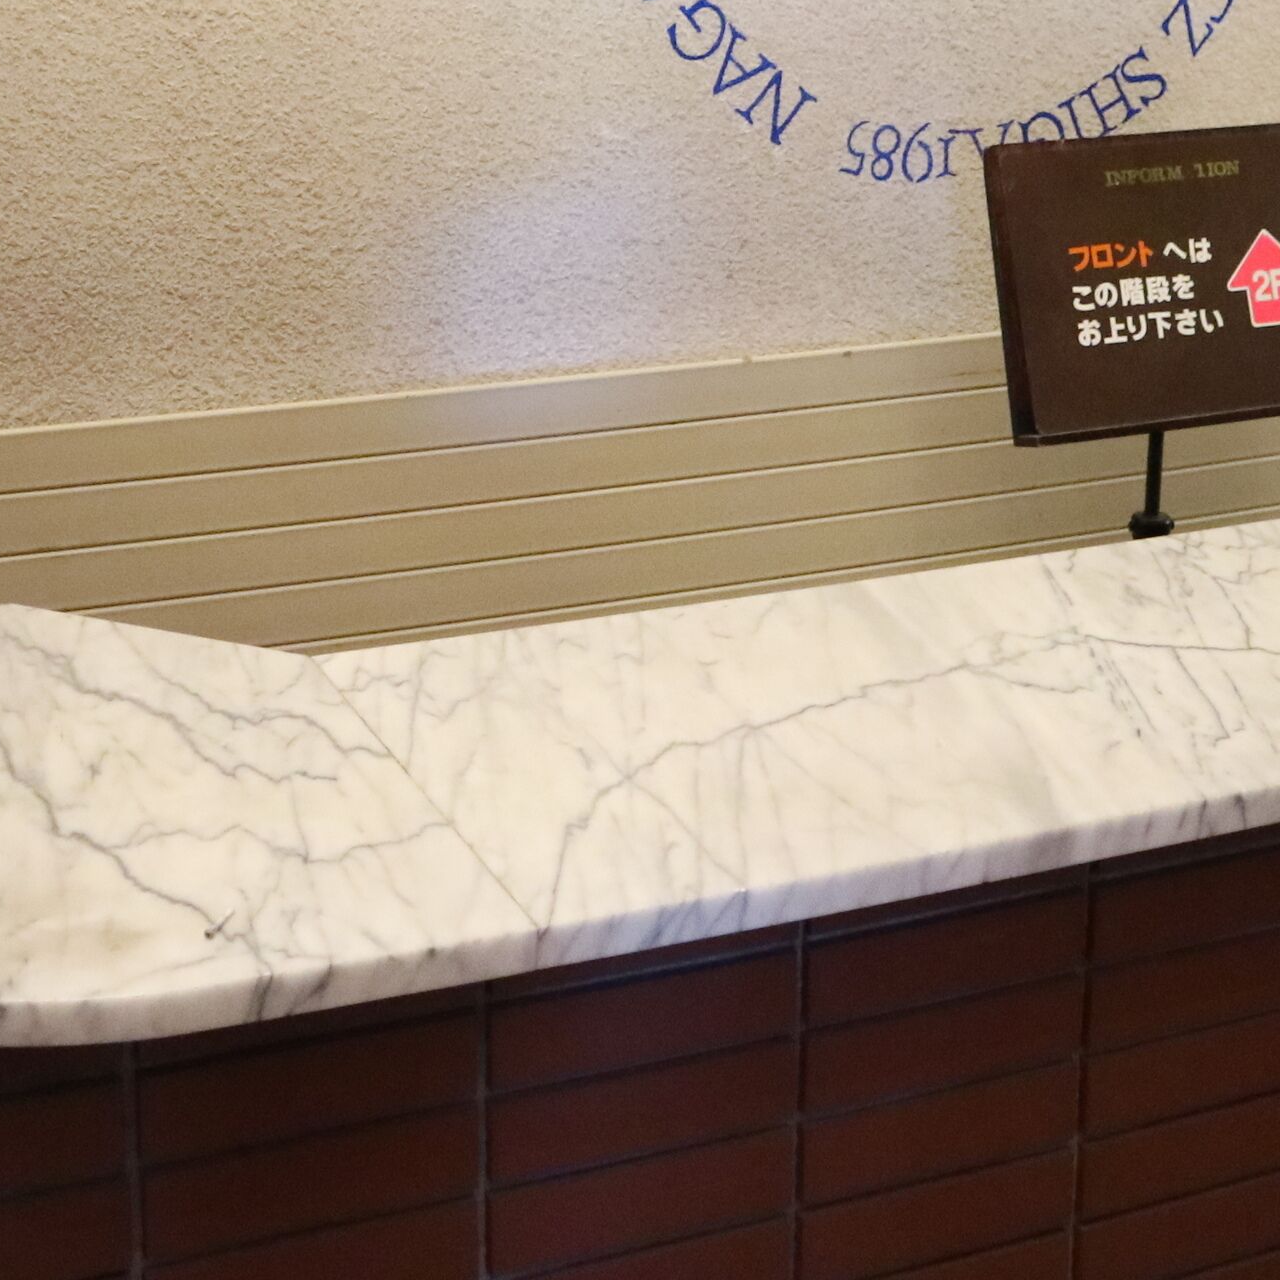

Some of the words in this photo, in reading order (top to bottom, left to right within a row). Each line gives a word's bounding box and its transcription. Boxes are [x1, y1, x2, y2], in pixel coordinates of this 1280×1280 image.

[839, 120, 957, 183] 1985
[1104, 160, 1240, 187] INFORMTION
[1072, 274, 1194, 311] この階段を
[1077, 308, 1224, 347] お上り下さい
